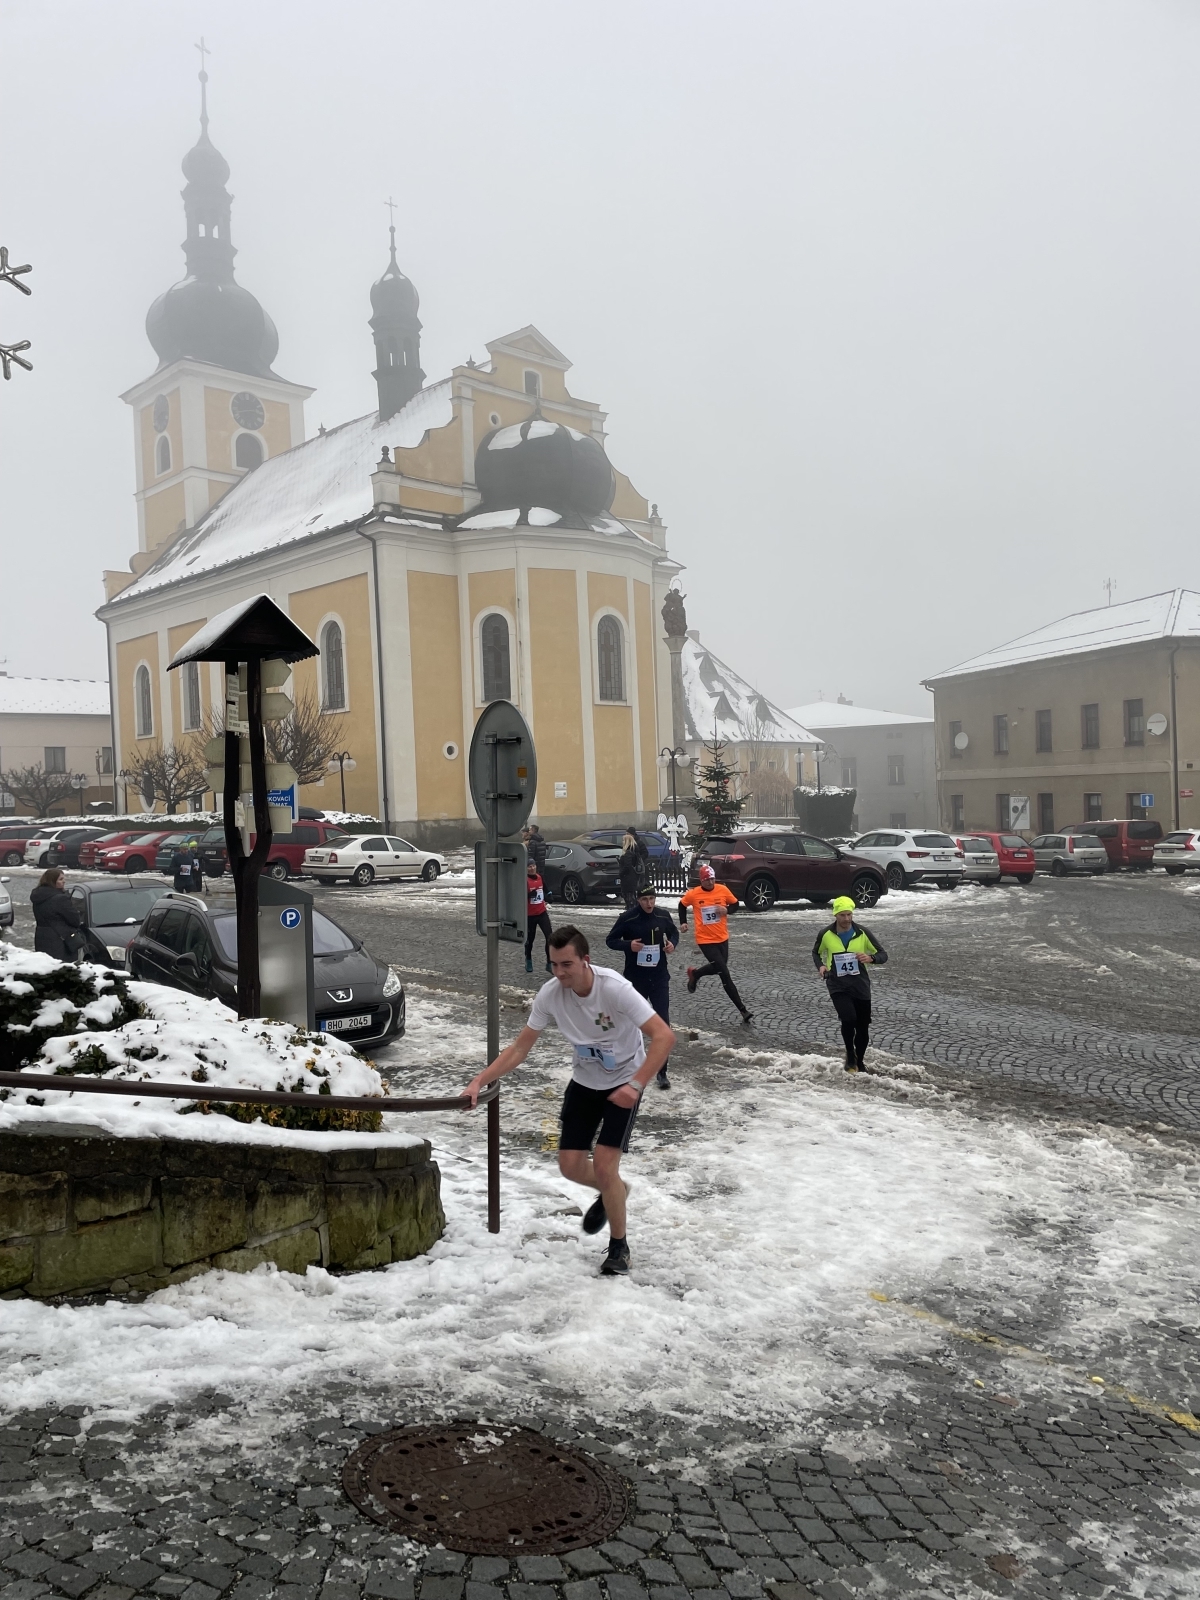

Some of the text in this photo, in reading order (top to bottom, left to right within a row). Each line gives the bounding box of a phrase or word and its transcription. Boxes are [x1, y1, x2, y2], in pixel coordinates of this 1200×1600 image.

[286, 911, 297, 925] P
[705, 912, 717, 921] 39
[645, 953, 653, 963] 8
[840, 961, 855, 972] 43
[348, 1016, 368, 1029] 2045
